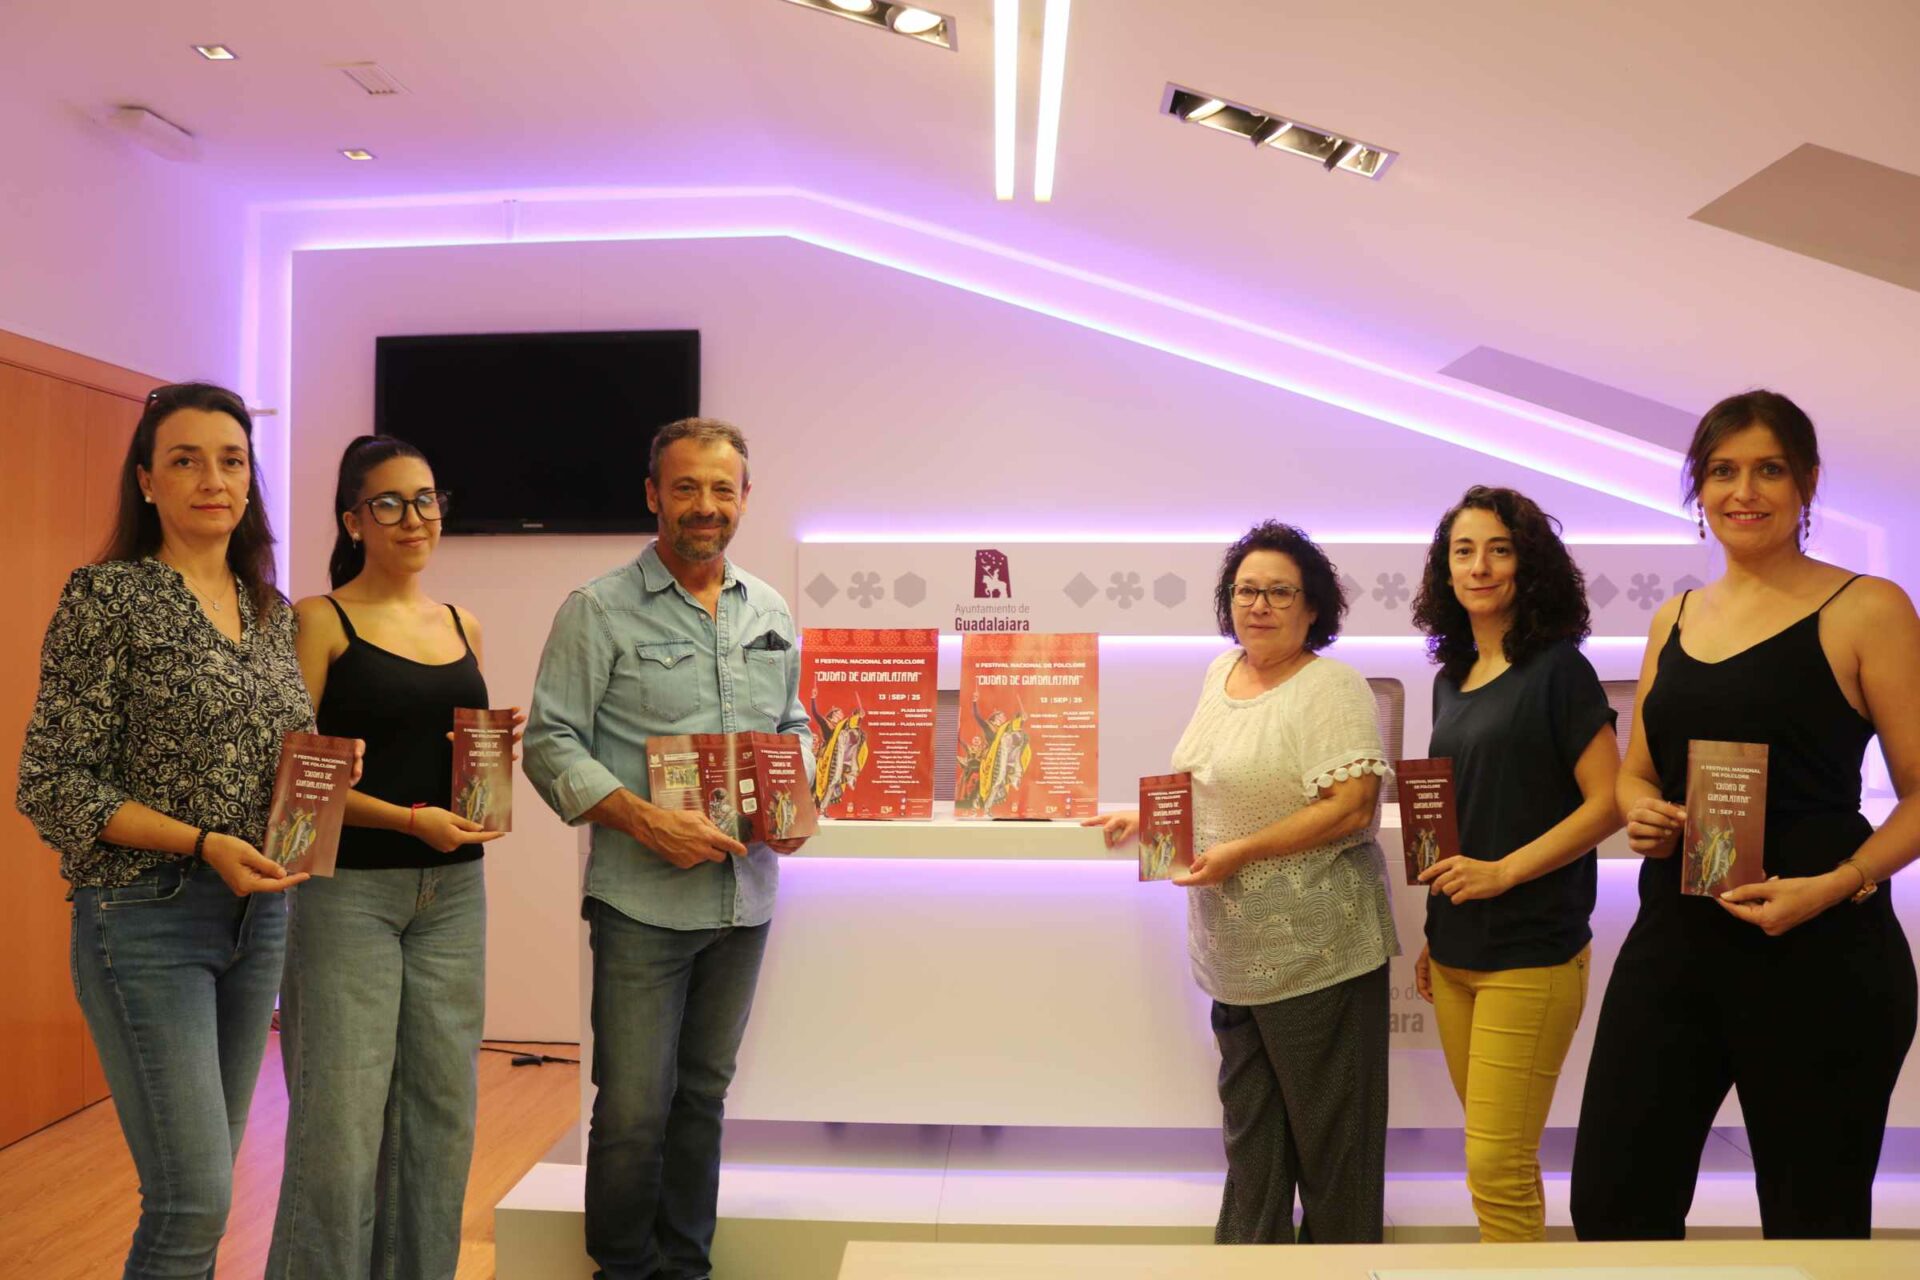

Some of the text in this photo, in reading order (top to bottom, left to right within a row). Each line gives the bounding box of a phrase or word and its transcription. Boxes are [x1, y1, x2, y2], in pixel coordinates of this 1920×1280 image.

[955, 604, 1030, 615] Ayuntamiento de
[955, 617, 1030, 631] Guadalajara
[848, 671, 860, 682] DE
